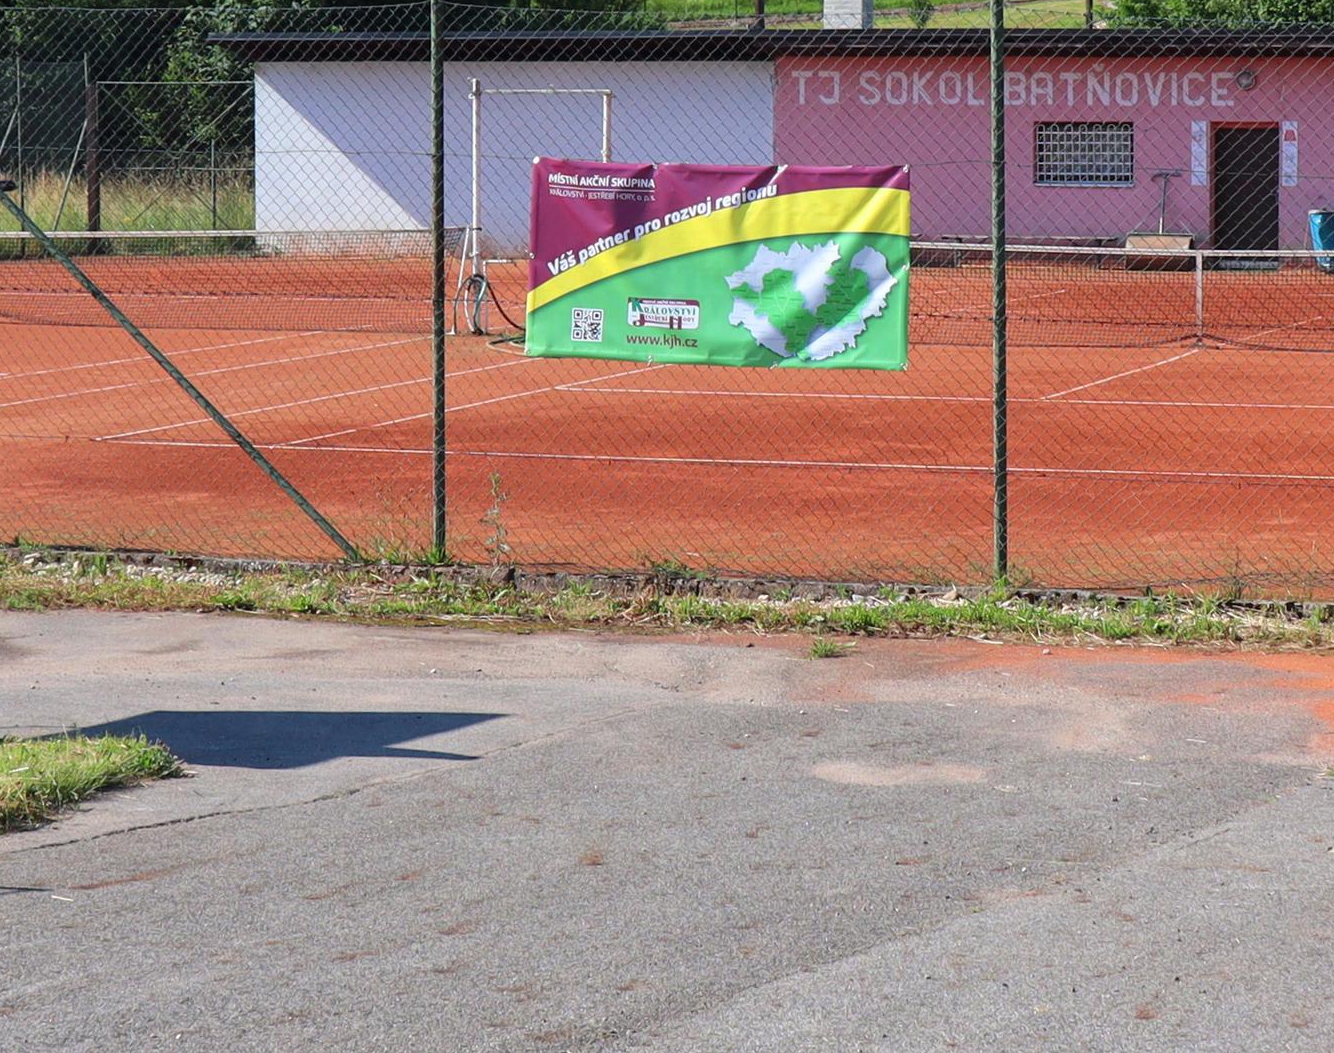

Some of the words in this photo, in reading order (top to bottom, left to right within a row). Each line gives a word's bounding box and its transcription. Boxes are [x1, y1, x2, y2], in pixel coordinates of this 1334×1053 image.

[791, 70, 841, 105] TJ
[858, 70, 985, 107] SOKOL
[1003, 62, 1236, 107] BATŇOVICE
[548, 172, 579, 186] MÍSTNÍ
[579, 174, 610, 187] AKČNÍ
[611, 177, 656, 189] SKUPINA
[547, 249, 577, 276] Váš
[578, 228, 631, 265] partner
[633, 218, 662, 241] pro
[664, 196, 712, 227] rozvoj
[715, 183, 778, 211] regionu
[626, 334, 699, 349] www.kjh.cz
